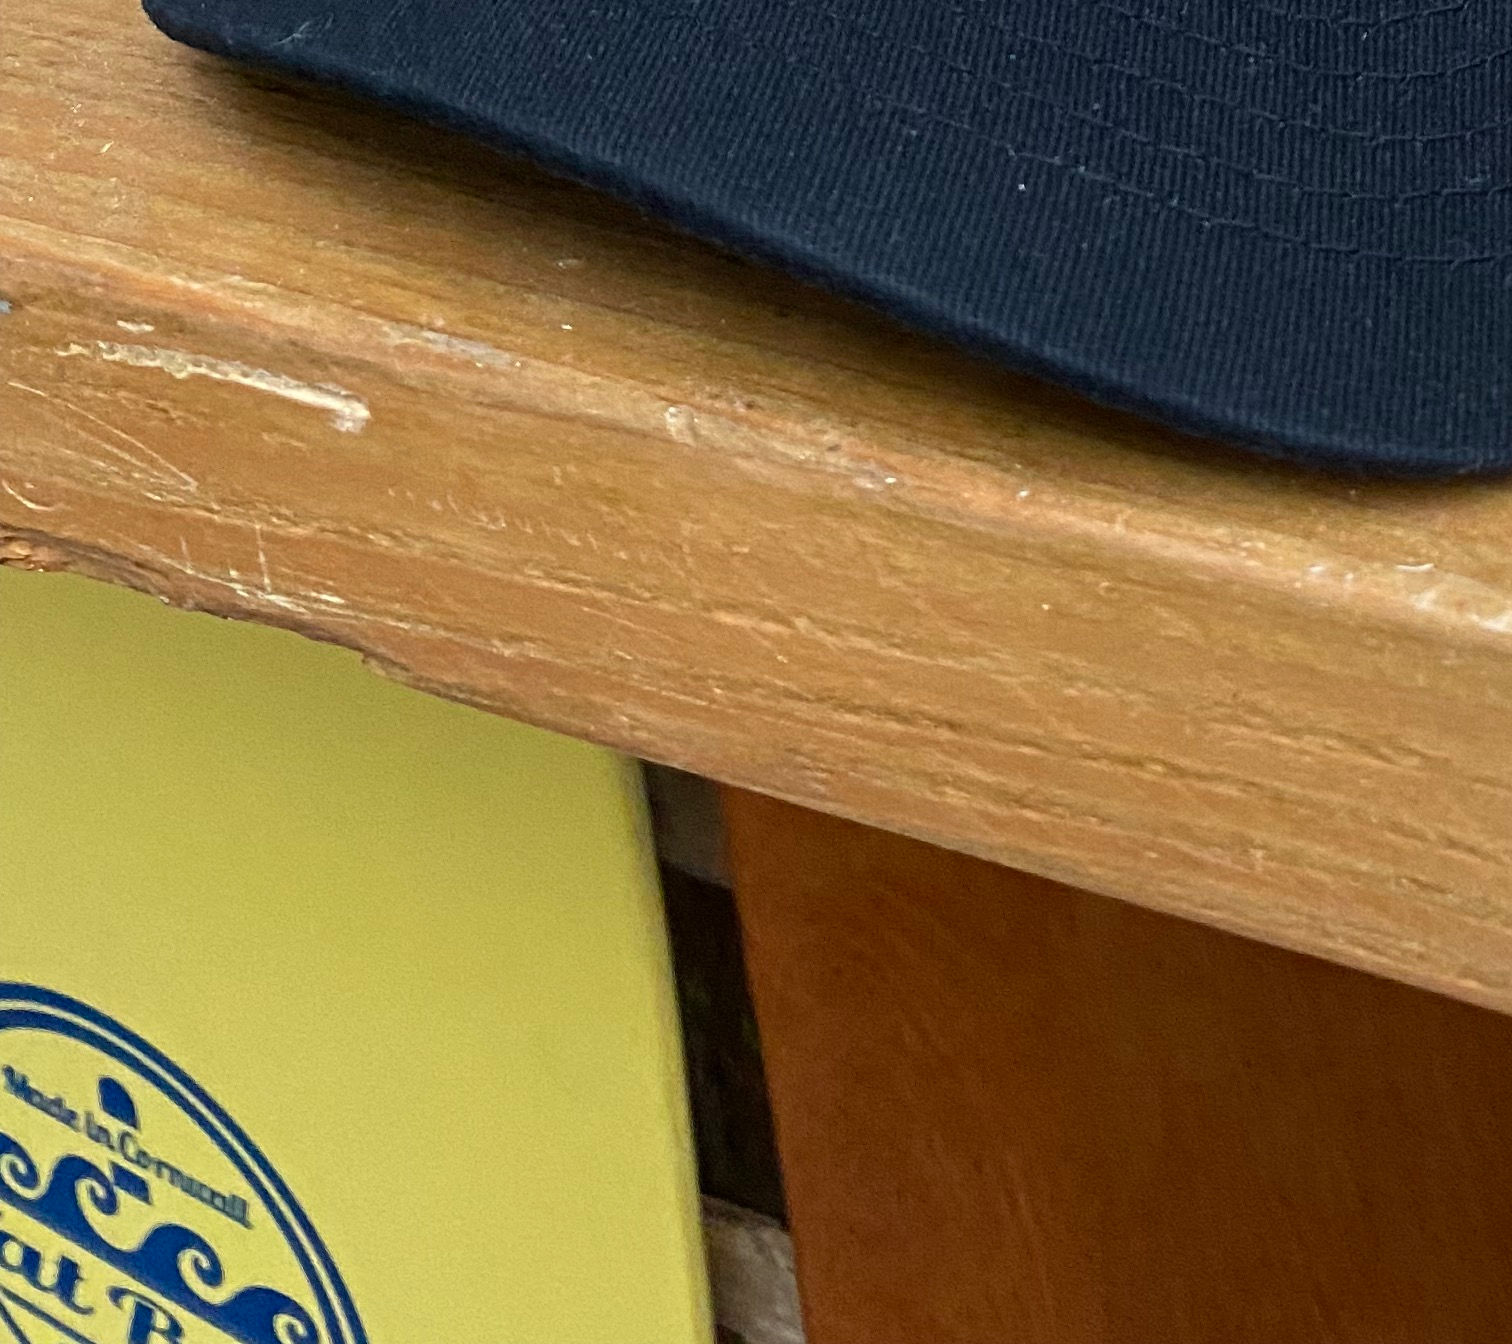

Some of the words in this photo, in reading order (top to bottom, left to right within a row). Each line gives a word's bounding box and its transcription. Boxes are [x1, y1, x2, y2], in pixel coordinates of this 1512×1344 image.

[2, 1064, 81, 1133] Made
[85, 1111, 116, 1152] in
[118, 1131, 255, 1230] Cornwall
[0, 1228, 95, 1316] at
